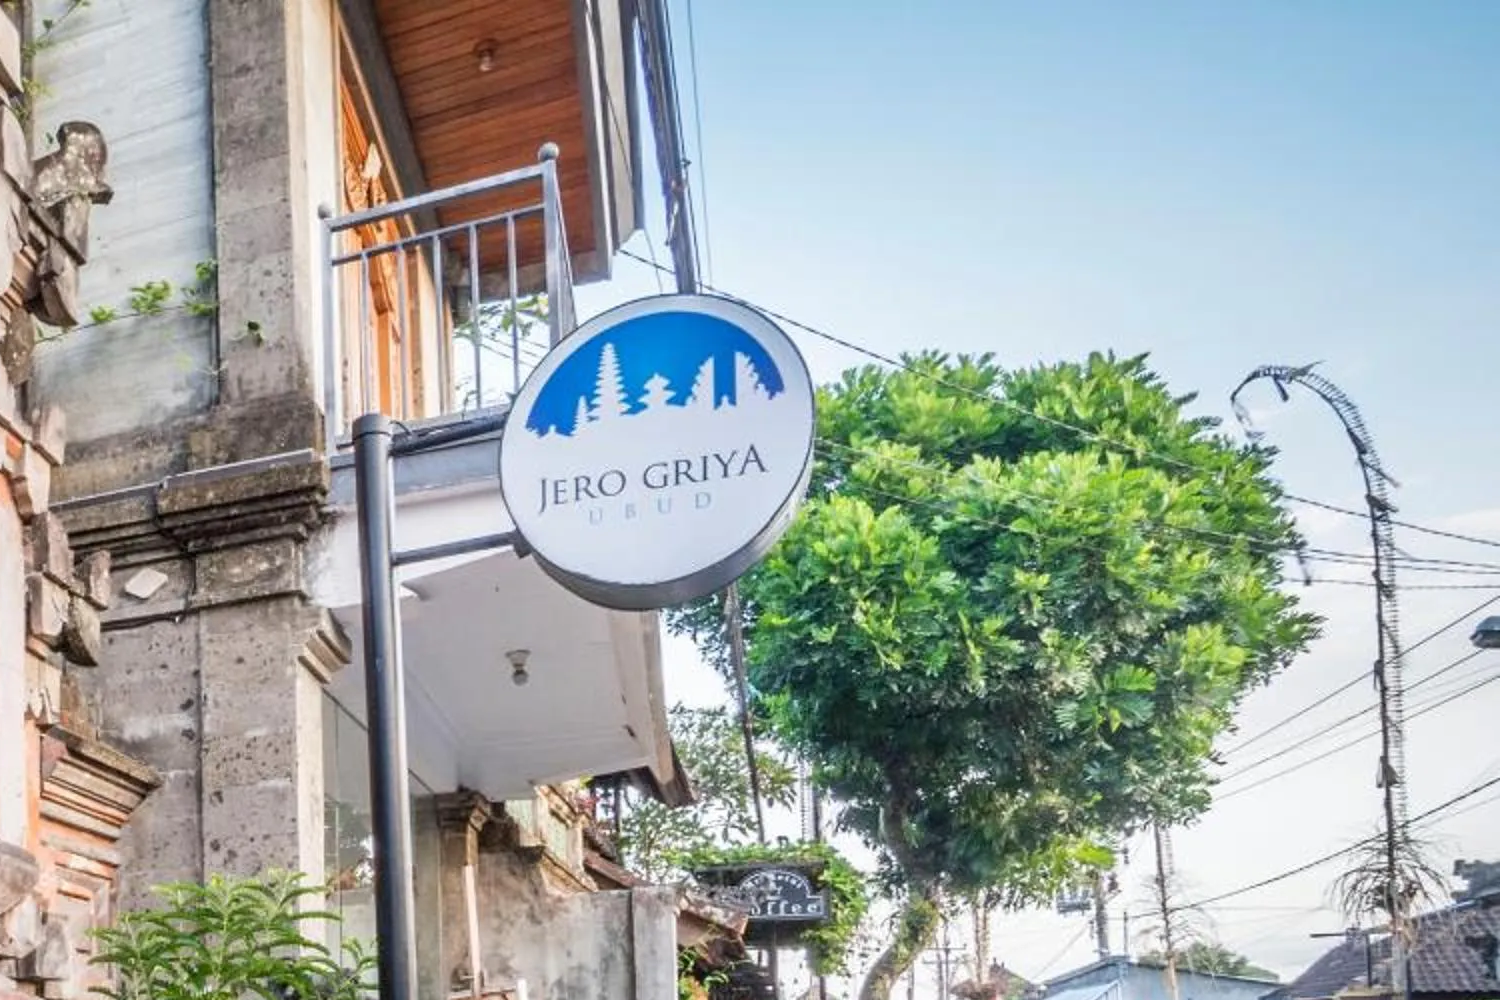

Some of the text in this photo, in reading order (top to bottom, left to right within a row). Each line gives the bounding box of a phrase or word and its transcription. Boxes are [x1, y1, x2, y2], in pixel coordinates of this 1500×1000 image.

[538, 443, 770, 514] JERO GRIYA
[588, 491, 712, 525] UBUD
[750, 899, 819, 916] offee
